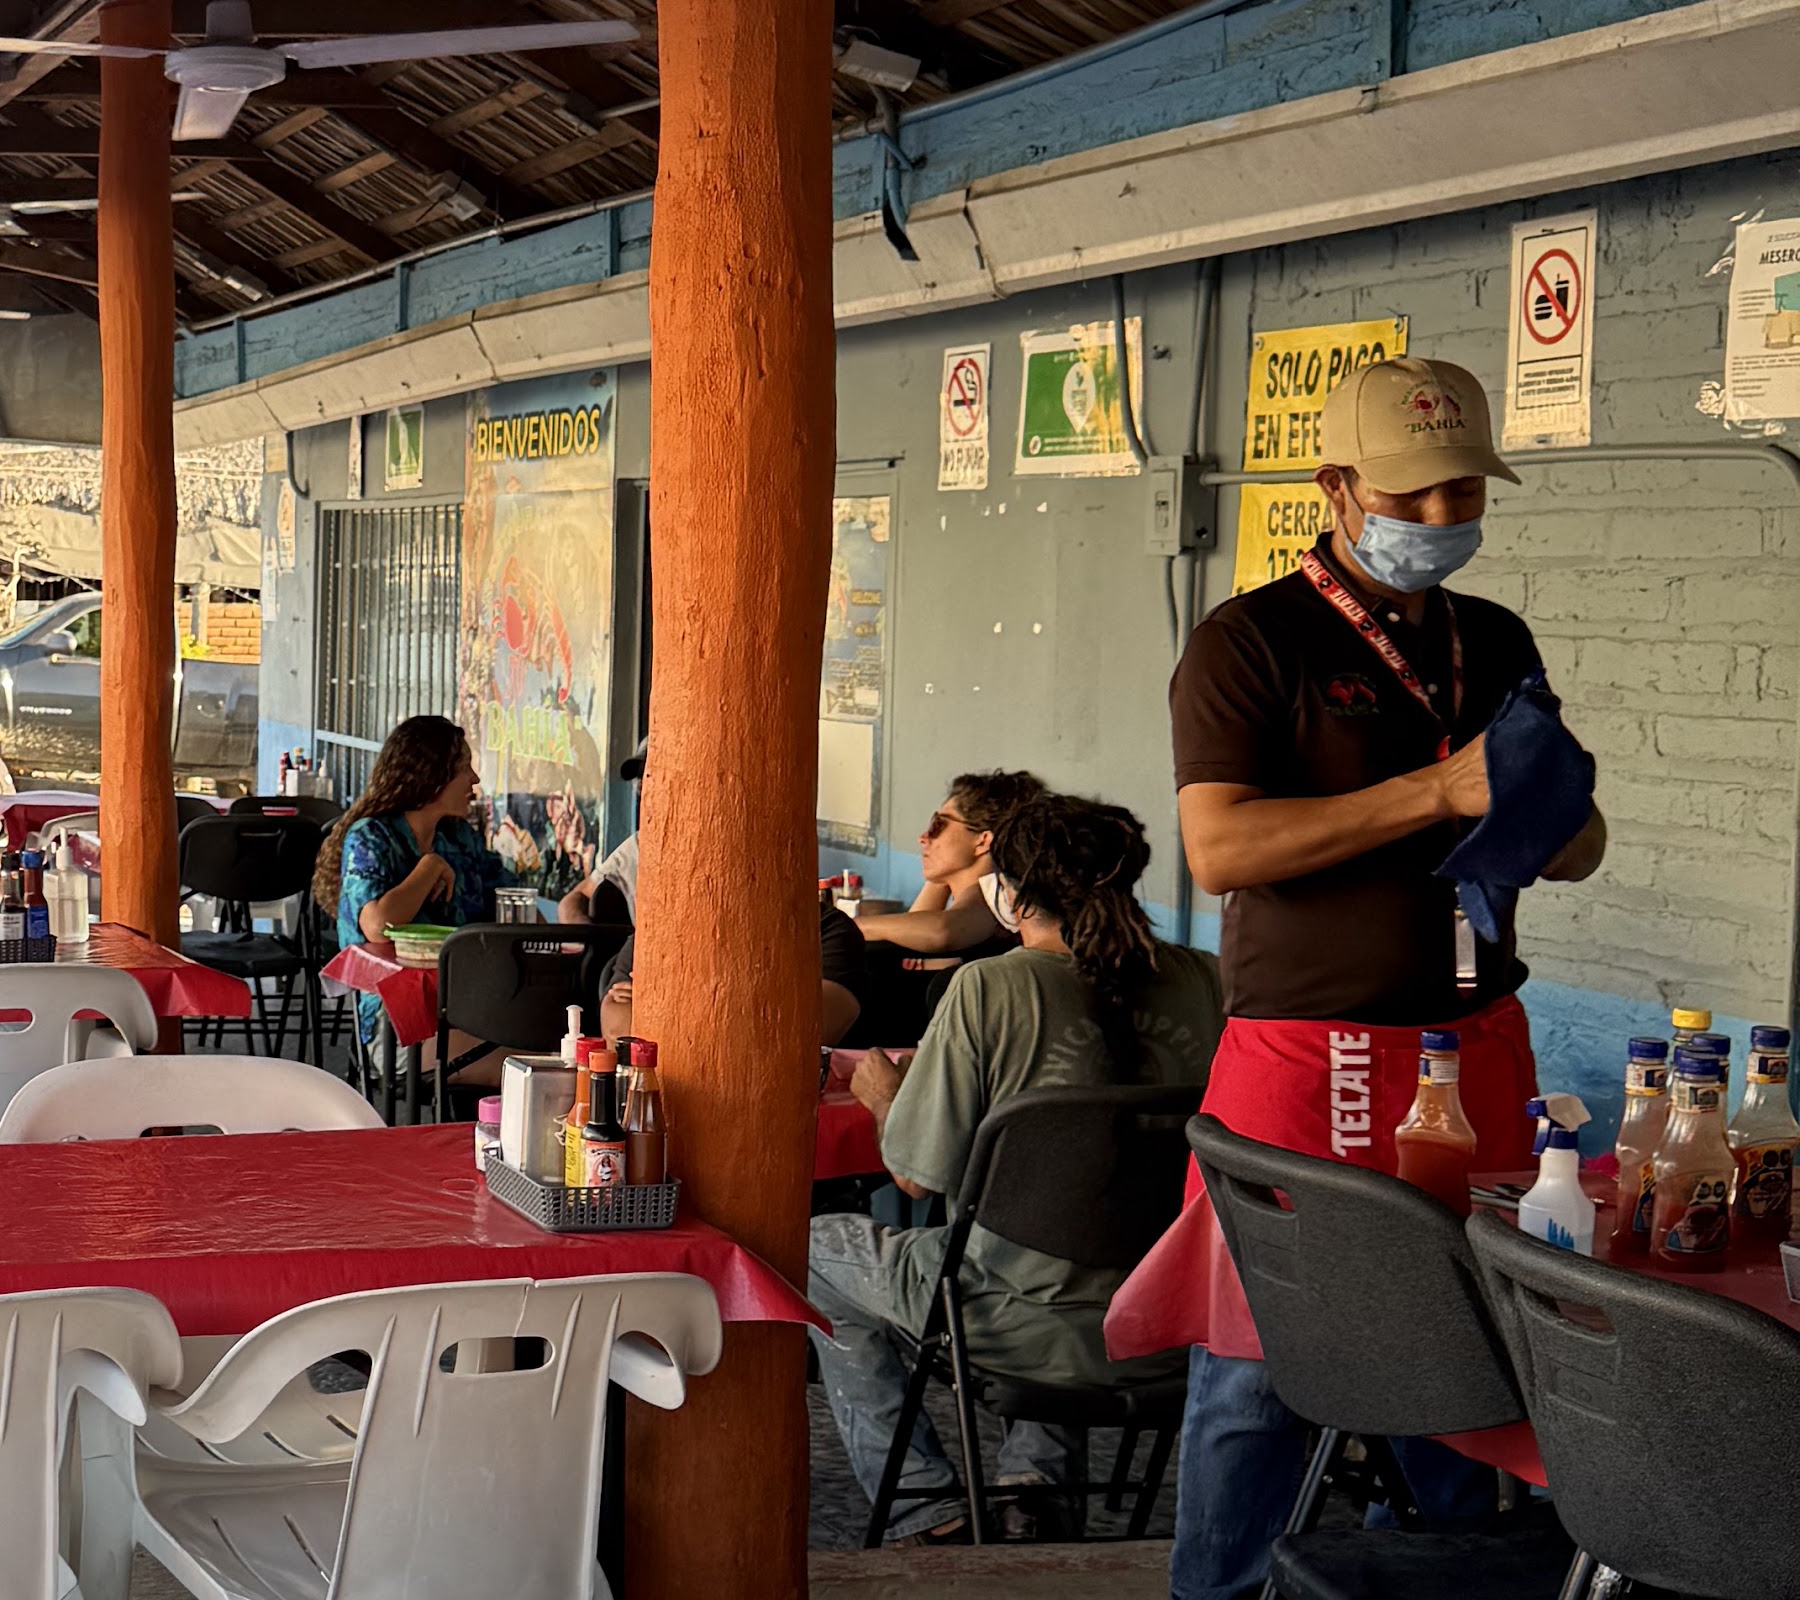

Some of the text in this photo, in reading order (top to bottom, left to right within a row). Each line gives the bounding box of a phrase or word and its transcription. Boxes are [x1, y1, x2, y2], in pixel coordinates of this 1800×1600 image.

[1266, 349, 1322, 399] SOLO
[475, 406, 602, 463] BIENVENIDOS
[1253, 414, 1280, 459] EN
[1329, 1031, 1371, 1158] TECATE
